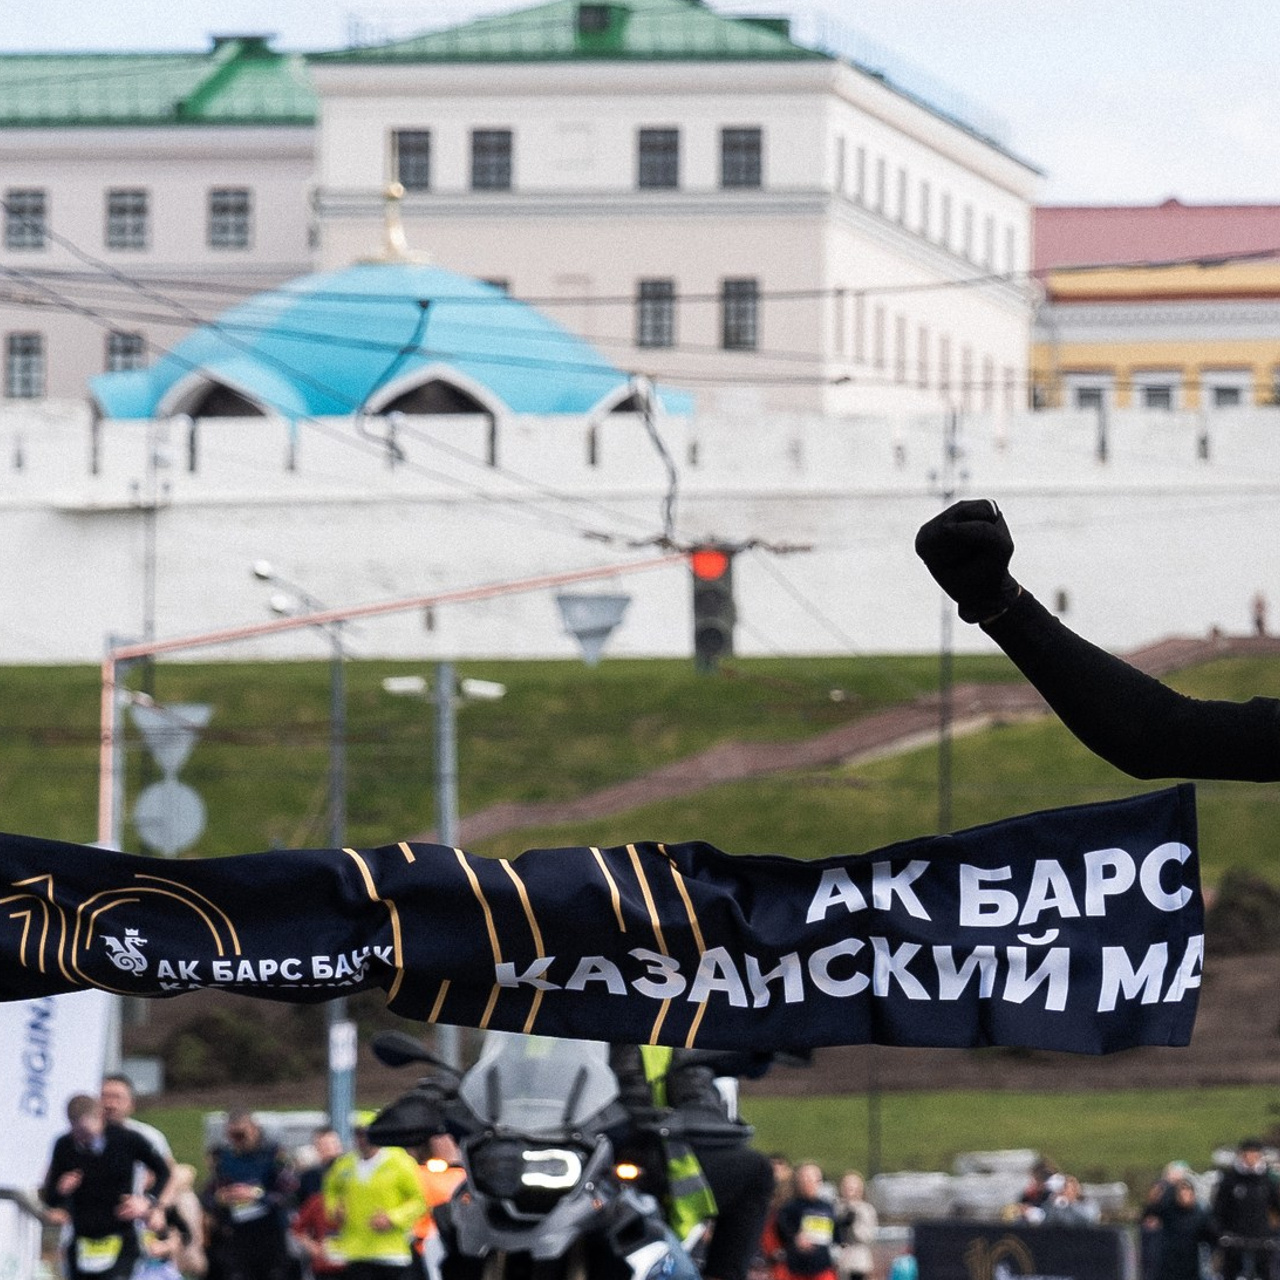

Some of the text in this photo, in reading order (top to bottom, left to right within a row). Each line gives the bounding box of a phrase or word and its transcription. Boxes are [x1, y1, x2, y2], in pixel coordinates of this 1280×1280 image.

[805, 841, 1194, 928] АК БАРС
[156, 960, 202, 982] АК
[212, 957, 302, 983] БАРС
[495, 928, 1071, 1013] КАЗАНСКИЙ
